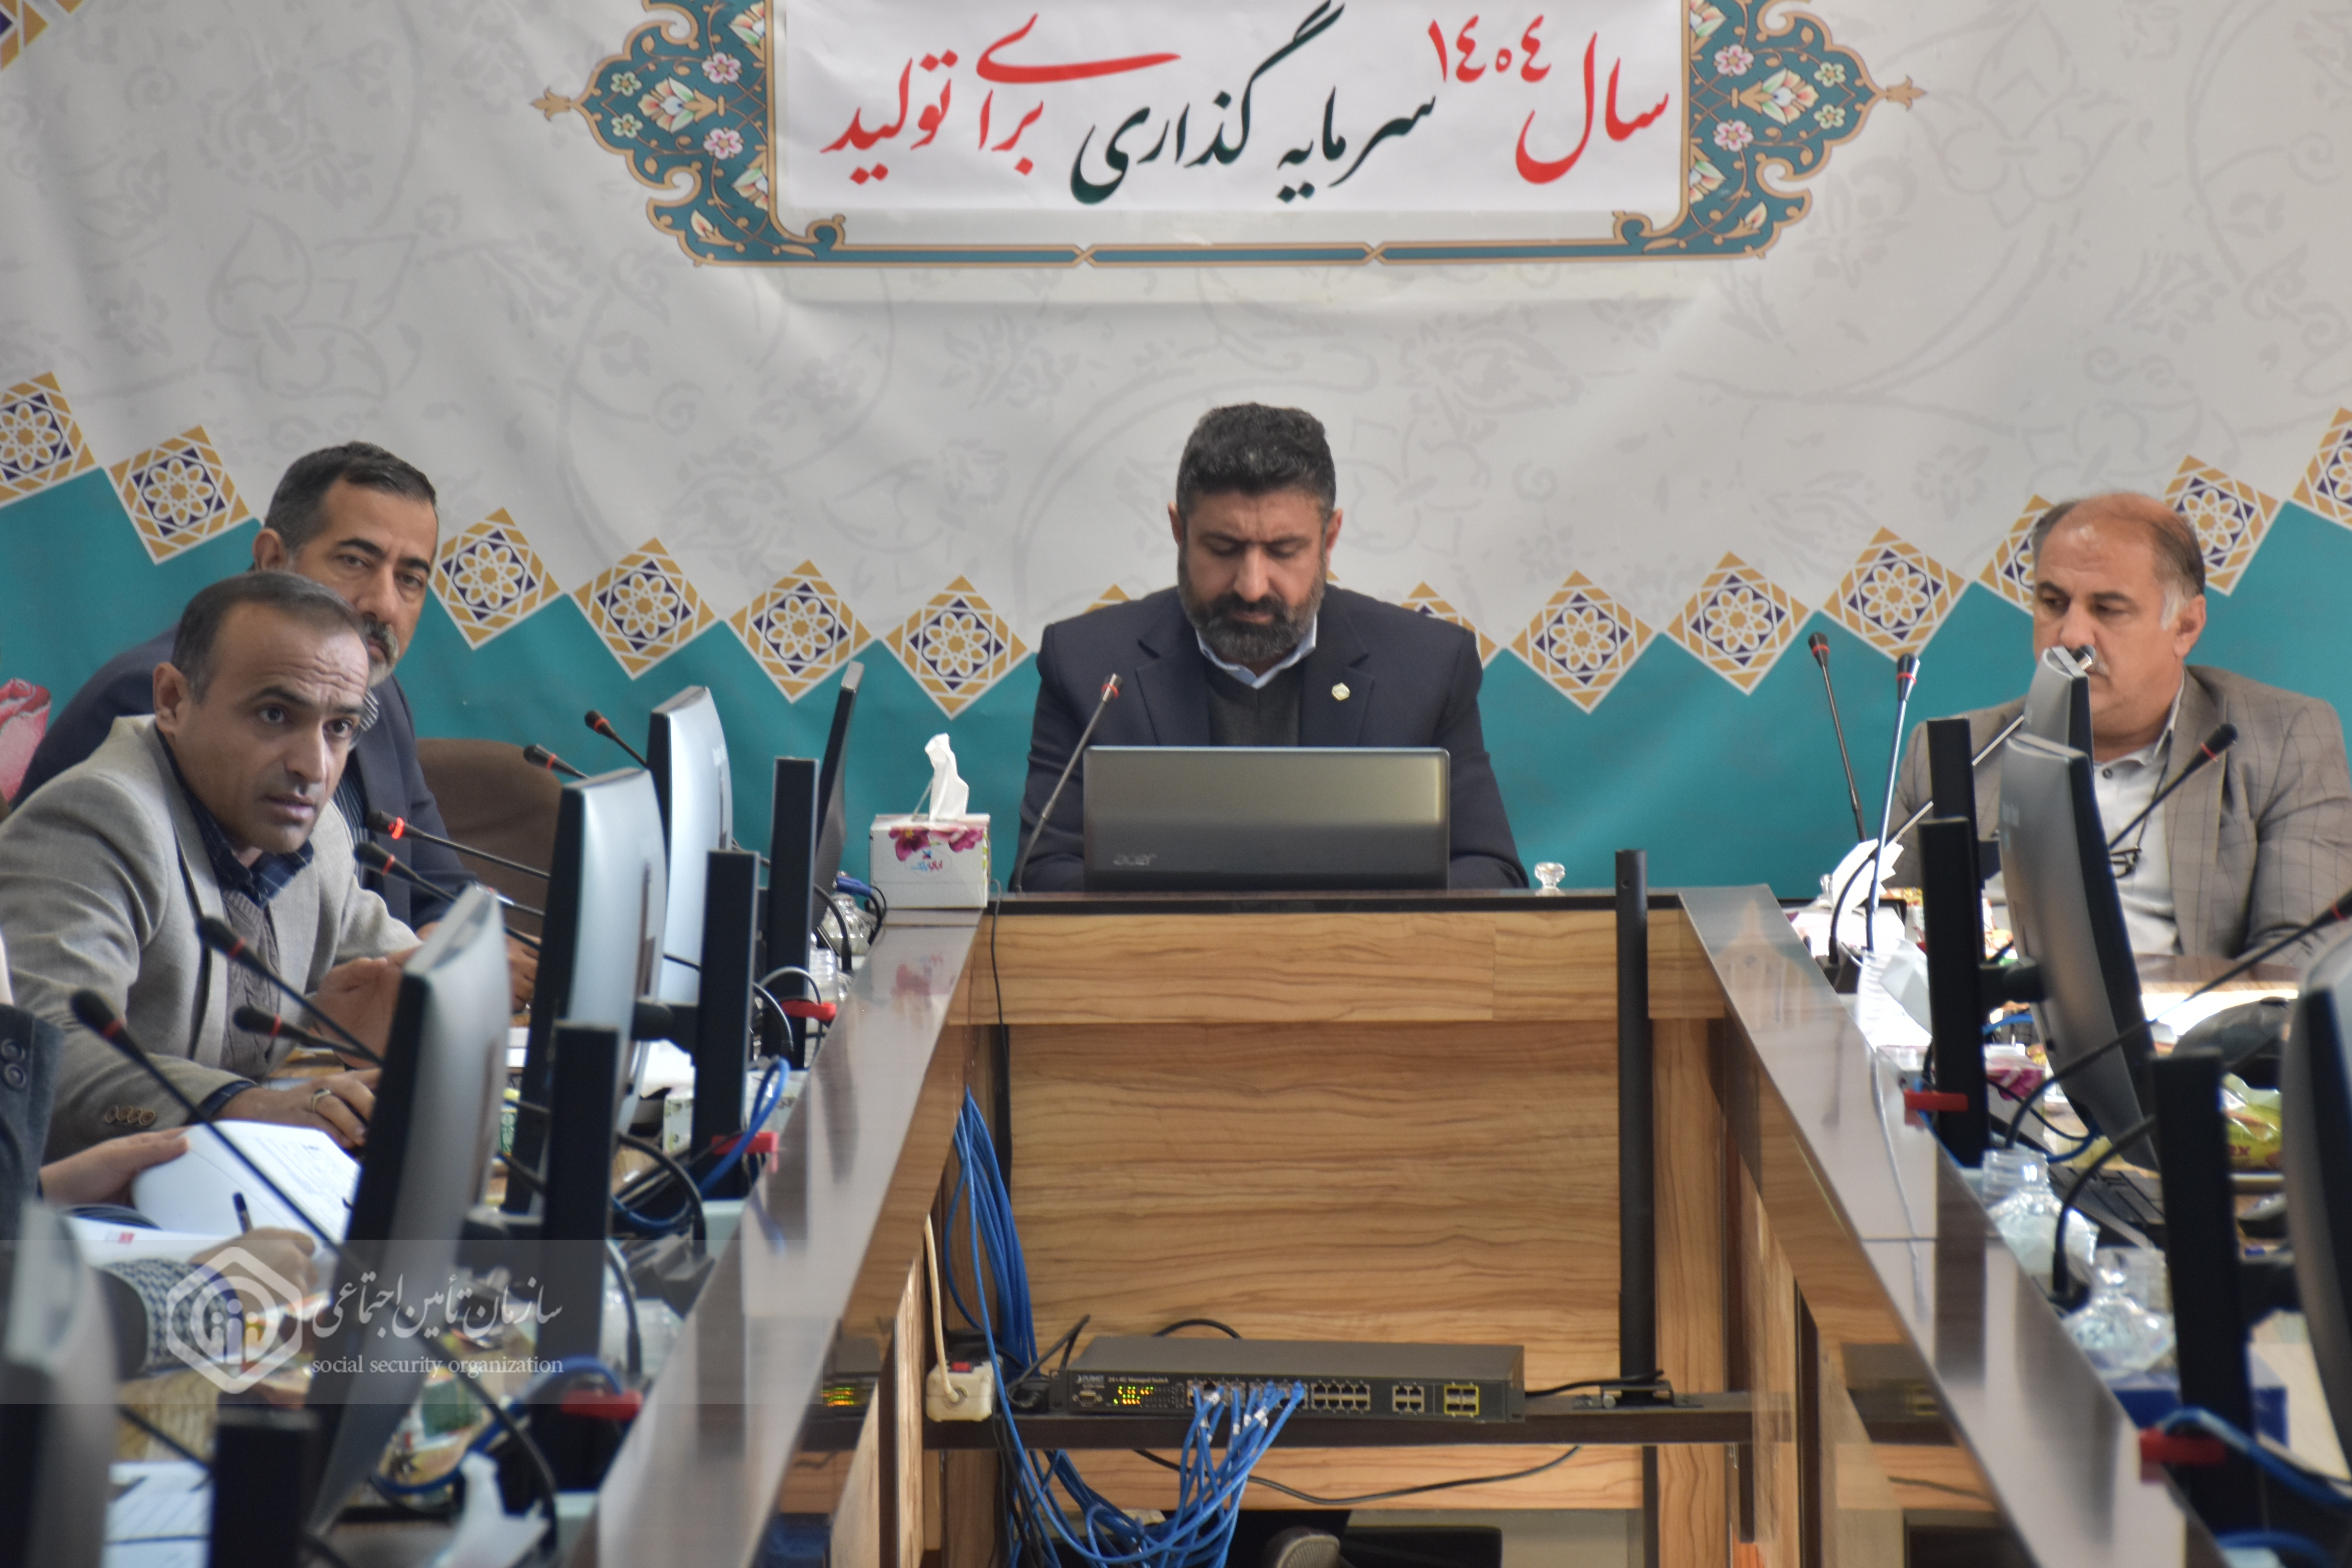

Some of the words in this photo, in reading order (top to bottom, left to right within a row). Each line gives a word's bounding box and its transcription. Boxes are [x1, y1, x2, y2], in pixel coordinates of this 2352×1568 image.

[821, 50, 958, 185] تولید
[976, 14, 1180, 175] برای
[1515, 32, 1669, 185] سال
